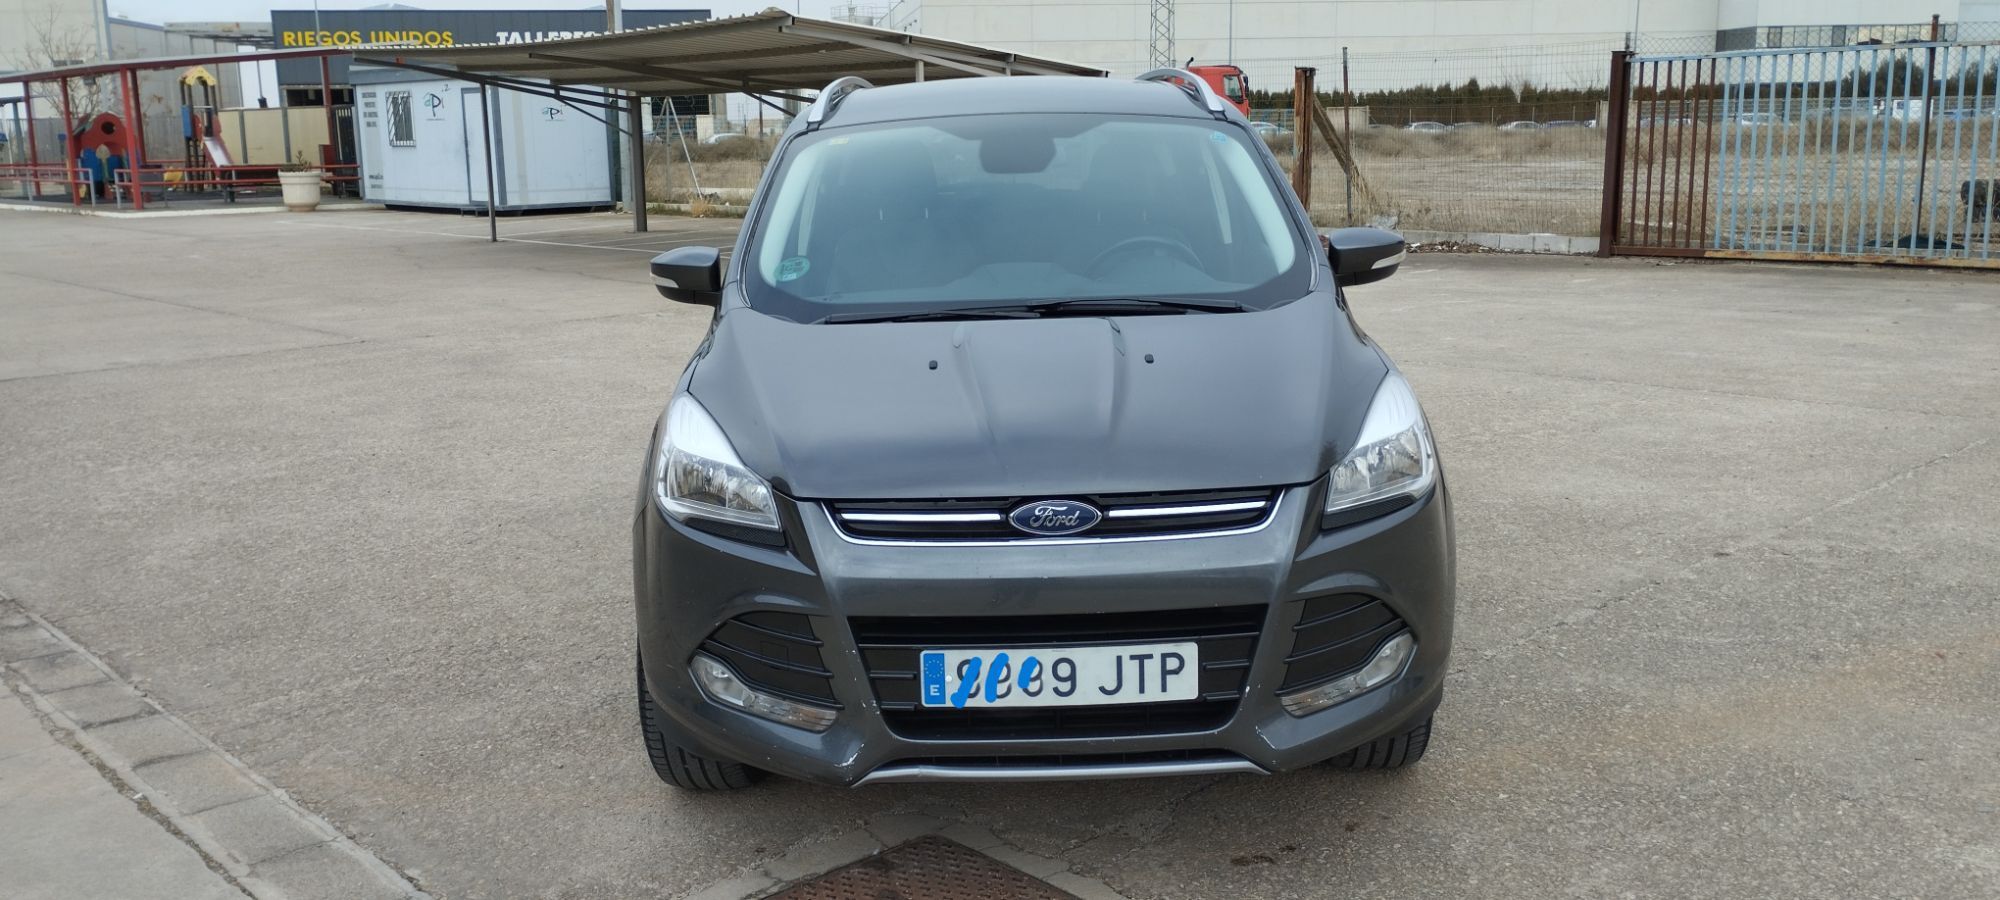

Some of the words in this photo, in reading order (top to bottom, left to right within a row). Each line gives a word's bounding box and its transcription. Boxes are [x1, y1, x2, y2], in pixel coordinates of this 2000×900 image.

[283, 31, 362, 46] RIEGOS
[370, 31, 454, 46] UNIDOS
[1029, 505, 1080, 528] Ford
[929, 684, 940, 696] E
[1098, 652, 1185, 697] JTP
